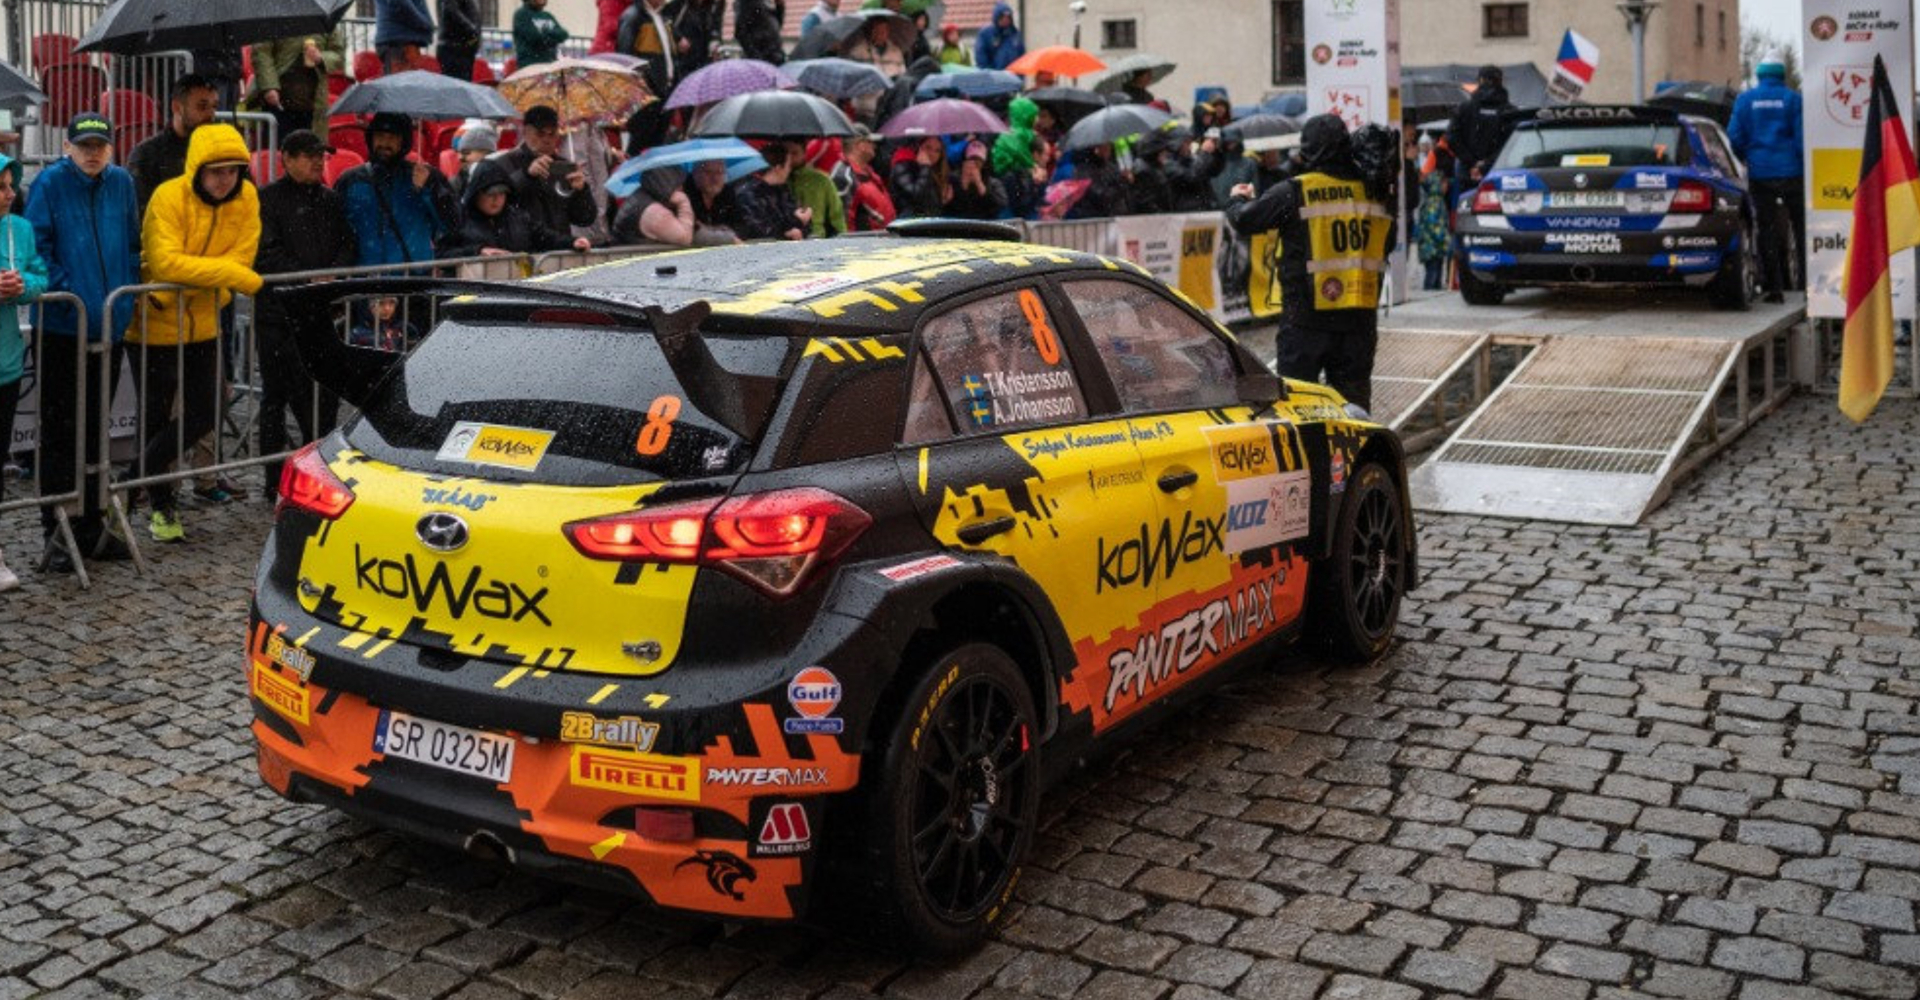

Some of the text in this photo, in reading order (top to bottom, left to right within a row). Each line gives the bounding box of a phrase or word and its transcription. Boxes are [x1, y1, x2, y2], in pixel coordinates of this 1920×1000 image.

[1307, 186, 1354, 202] MEDIA
[1017, 288, 1062, 366] 8
[983, 370, 1074, 398] T.Kristensson
[636, 395, 683, 455] 8
[993, 396, 1076, 425] A.Johansson
[1096, 510, 1225, 595] koWax
[354, 543, 553, 627] koWax
[1105, 574, 1277, 715] PANTERMAX
[792, 685, 839, 700] Gulf
[390, 719, 510, 778] SR 0325M
[561, 712, 661, 753] 2Brally
[579, 752, 687, 791] PIRELLI
[705, 767, 829, 786] PANTERMAX
